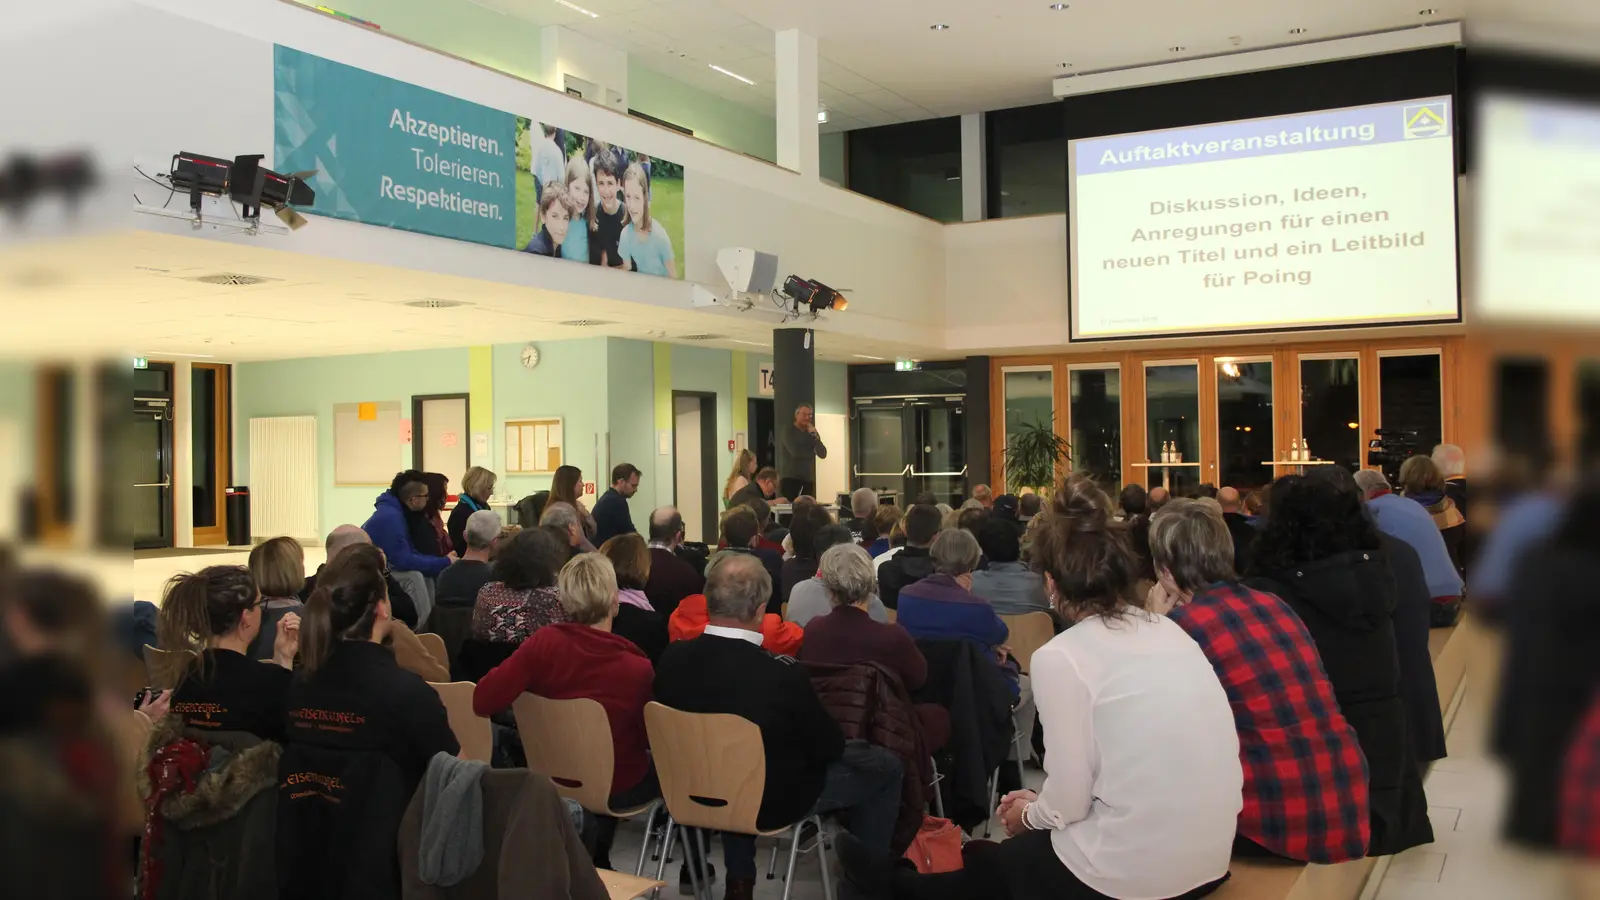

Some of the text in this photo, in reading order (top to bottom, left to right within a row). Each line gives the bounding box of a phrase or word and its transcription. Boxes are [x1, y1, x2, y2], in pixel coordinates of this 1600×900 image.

[389, 108, 503, 156] Akzeptieren.
[1100, 122, 1375, 166] Auftaktveranstaltung
[411, 147, 503, 188] Tolerieren.
[380, 175, 502, 220] Respektieren.
[1149, 183, 1367, 216] Diskussion, Ideen,
[1131, 208, 1389, 242] Anregungen für einen
[1102, 231, 1425, 271] neuen Titel und ein Leitbild
[1203, 268, 1312, 288] für Poing
